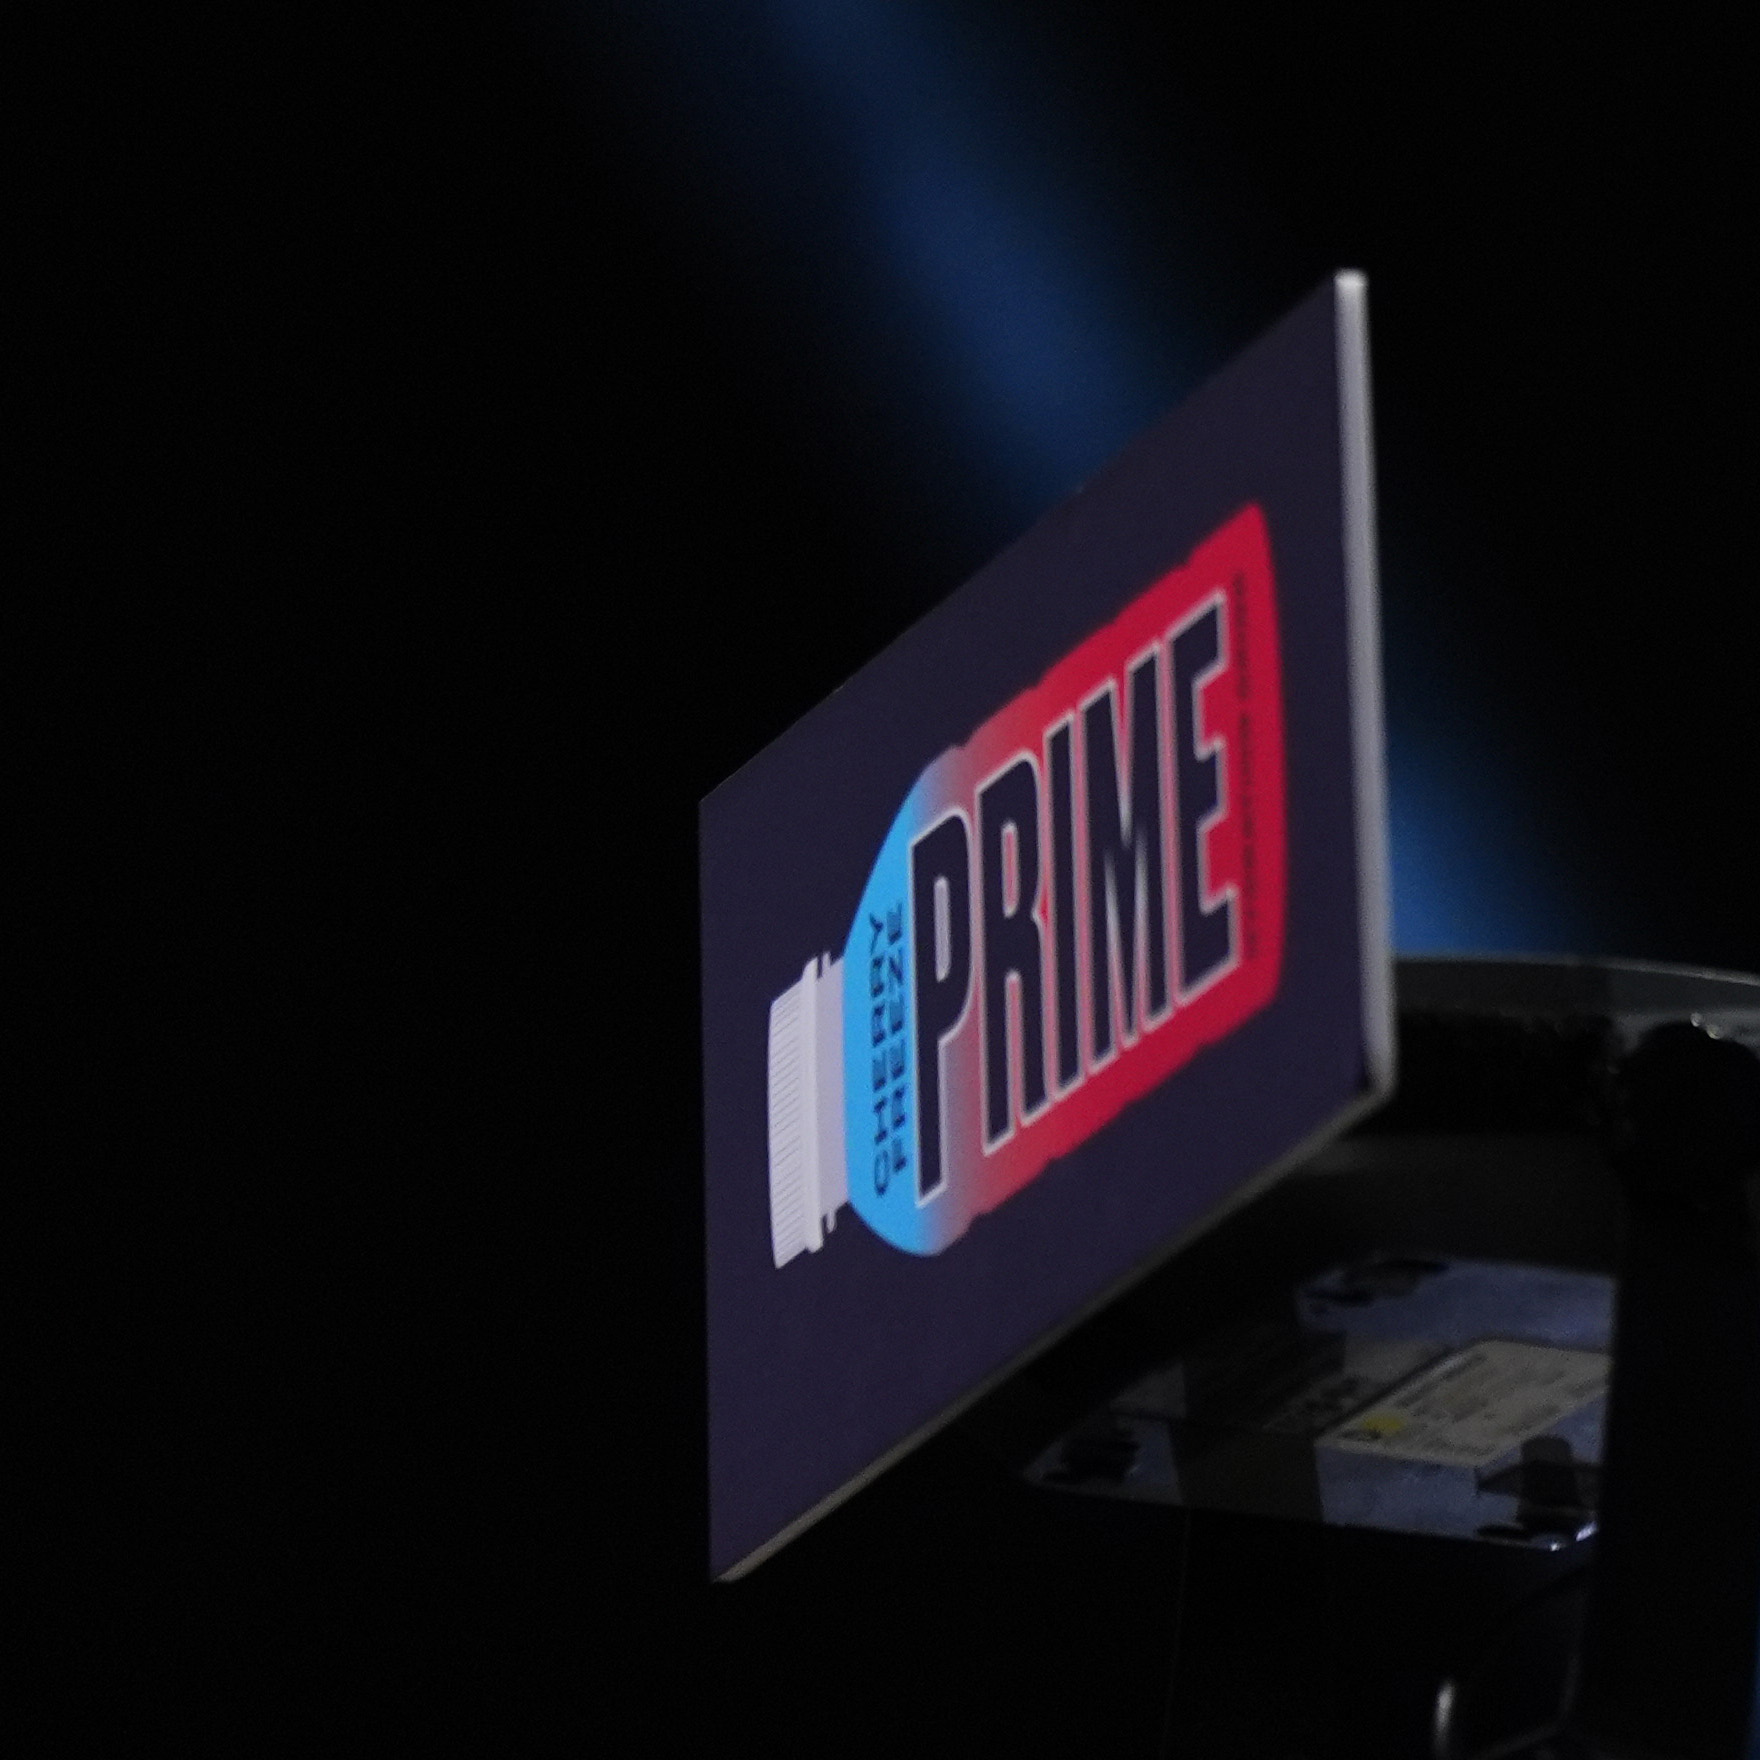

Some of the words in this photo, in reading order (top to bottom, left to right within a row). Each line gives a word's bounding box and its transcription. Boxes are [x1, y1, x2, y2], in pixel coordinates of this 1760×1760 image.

[886, 900, 907, 1174] FREEZE
[908, 587, 1243, 1208] PRIME
[870, 910, 889, 1197] CHERRY
